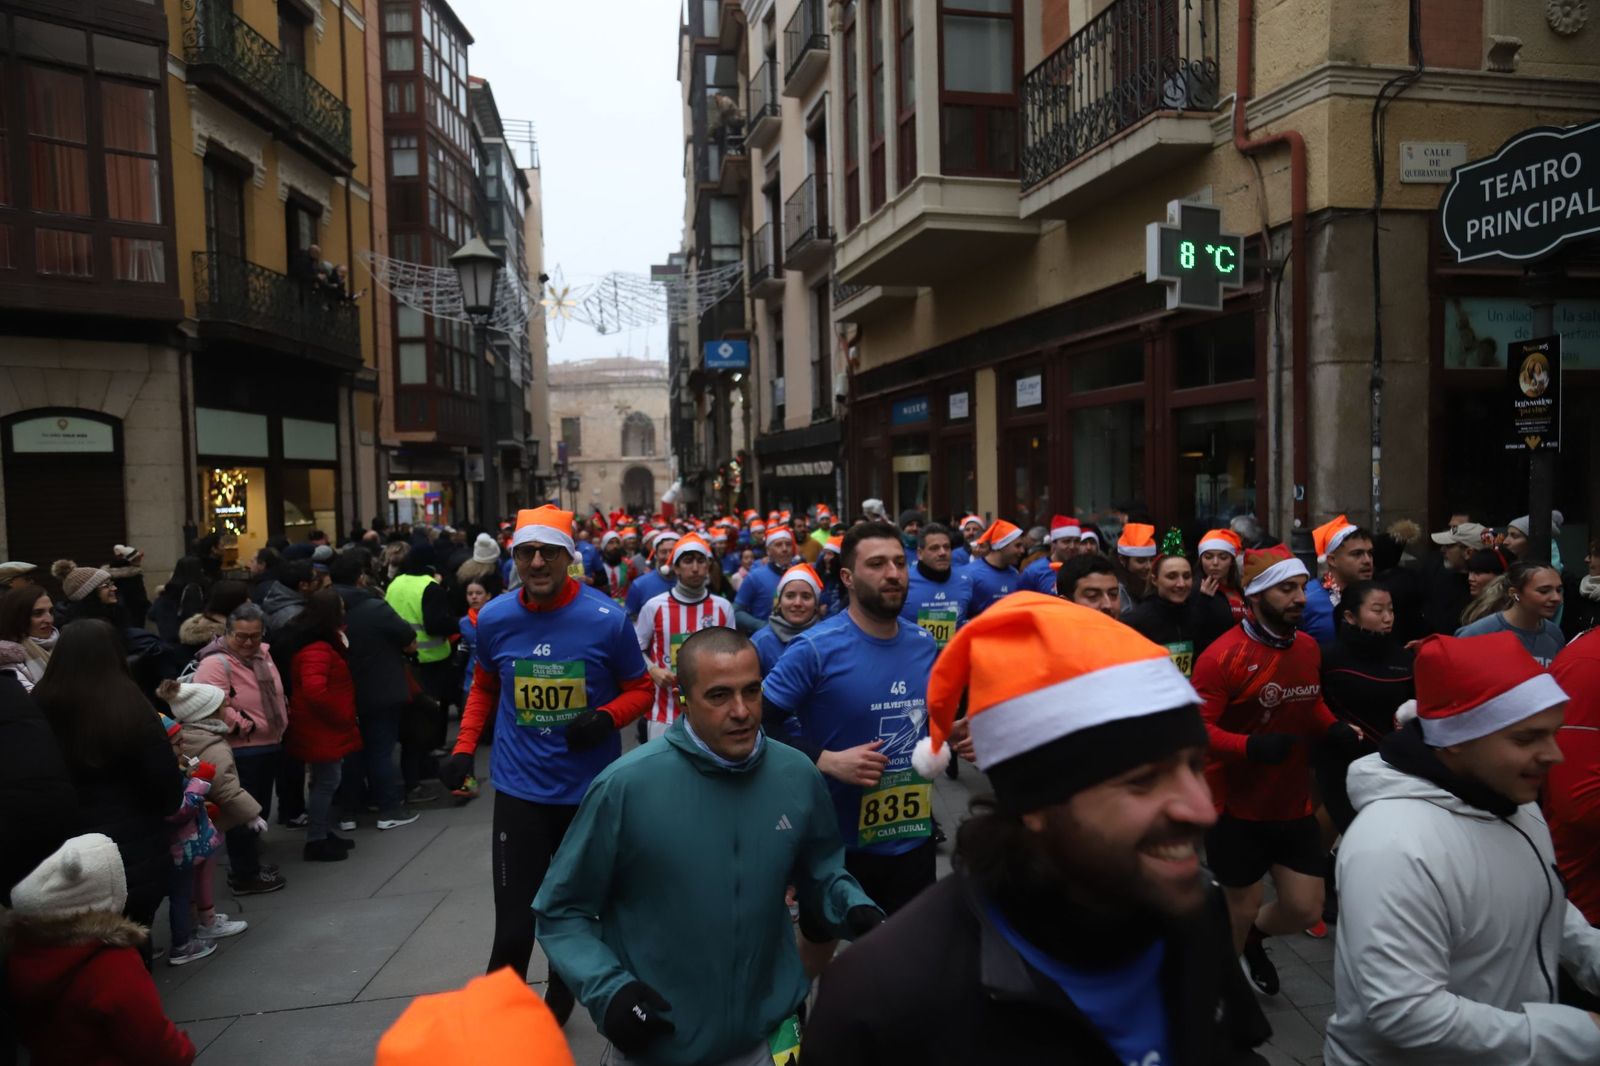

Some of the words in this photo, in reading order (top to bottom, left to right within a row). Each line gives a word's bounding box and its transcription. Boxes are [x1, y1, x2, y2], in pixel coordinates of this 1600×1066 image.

[1424, 148, 1452, 157] CALLE
[1429, 159, 1441, 167] DE
[1404, 169, 1452, 178] QUEBRANTAHU
[1479, 152, 1582, 202] TEATRO
[1466, 188, 1600, 243] PRINCIPAL
[1180, 241, 1195, 269] 8
[1487, 308, 1503, 322] Un
[1506, 307, 1532, 322] aliad
[1562, 307, 1575, 322] la
[532, 643, 551, 657] 46
[889, 681, 907, 695] 46
[520, 684, 574, 710] 1307
[870, 703, 882, 711] SAN
[883, 700, 912, 710] SILVESTRE
[556, 711, 579, 721] RURA
[864, 792, 920, 827] 835
[897, 823, 927, 833] RURAL
